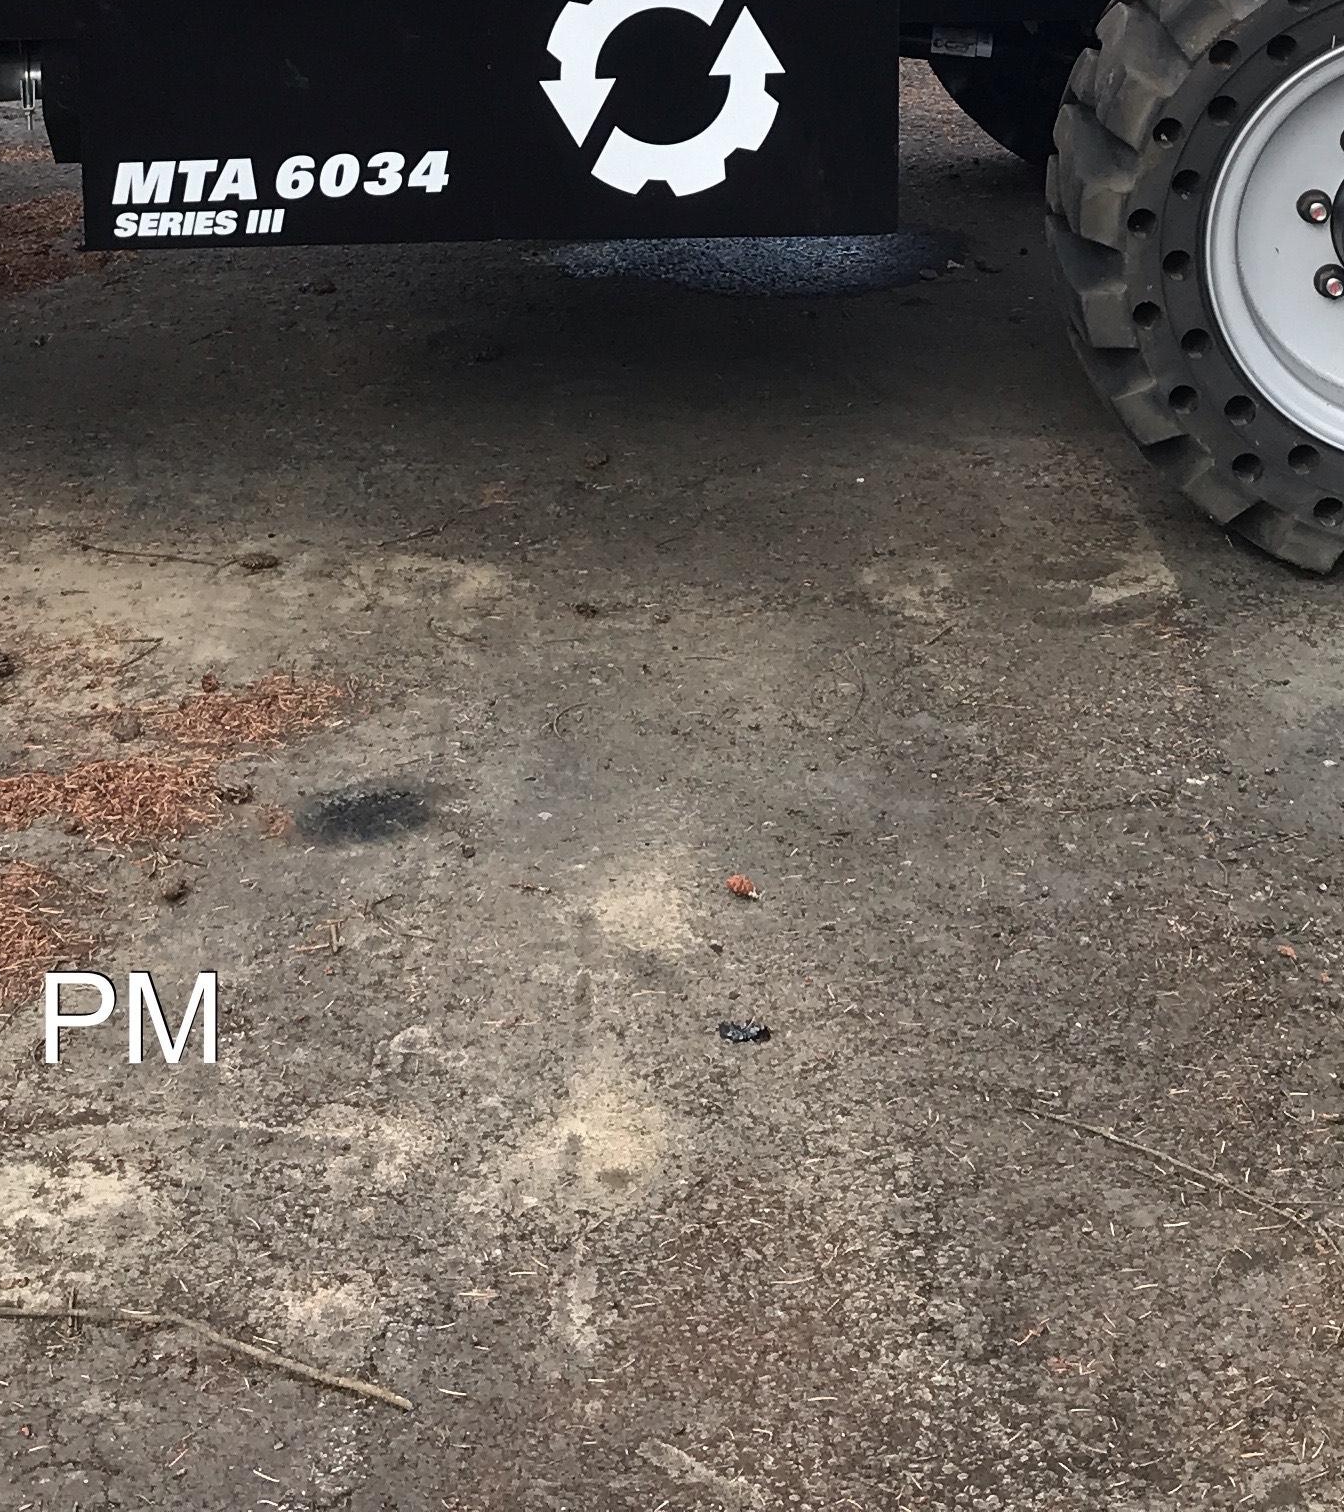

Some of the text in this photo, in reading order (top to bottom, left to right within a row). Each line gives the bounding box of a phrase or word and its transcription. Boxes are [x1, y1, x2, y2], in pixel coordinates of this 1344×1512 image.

[111, 149, 450, 205] MTA 6034
[112, 208, 286, 238] SERIES III
